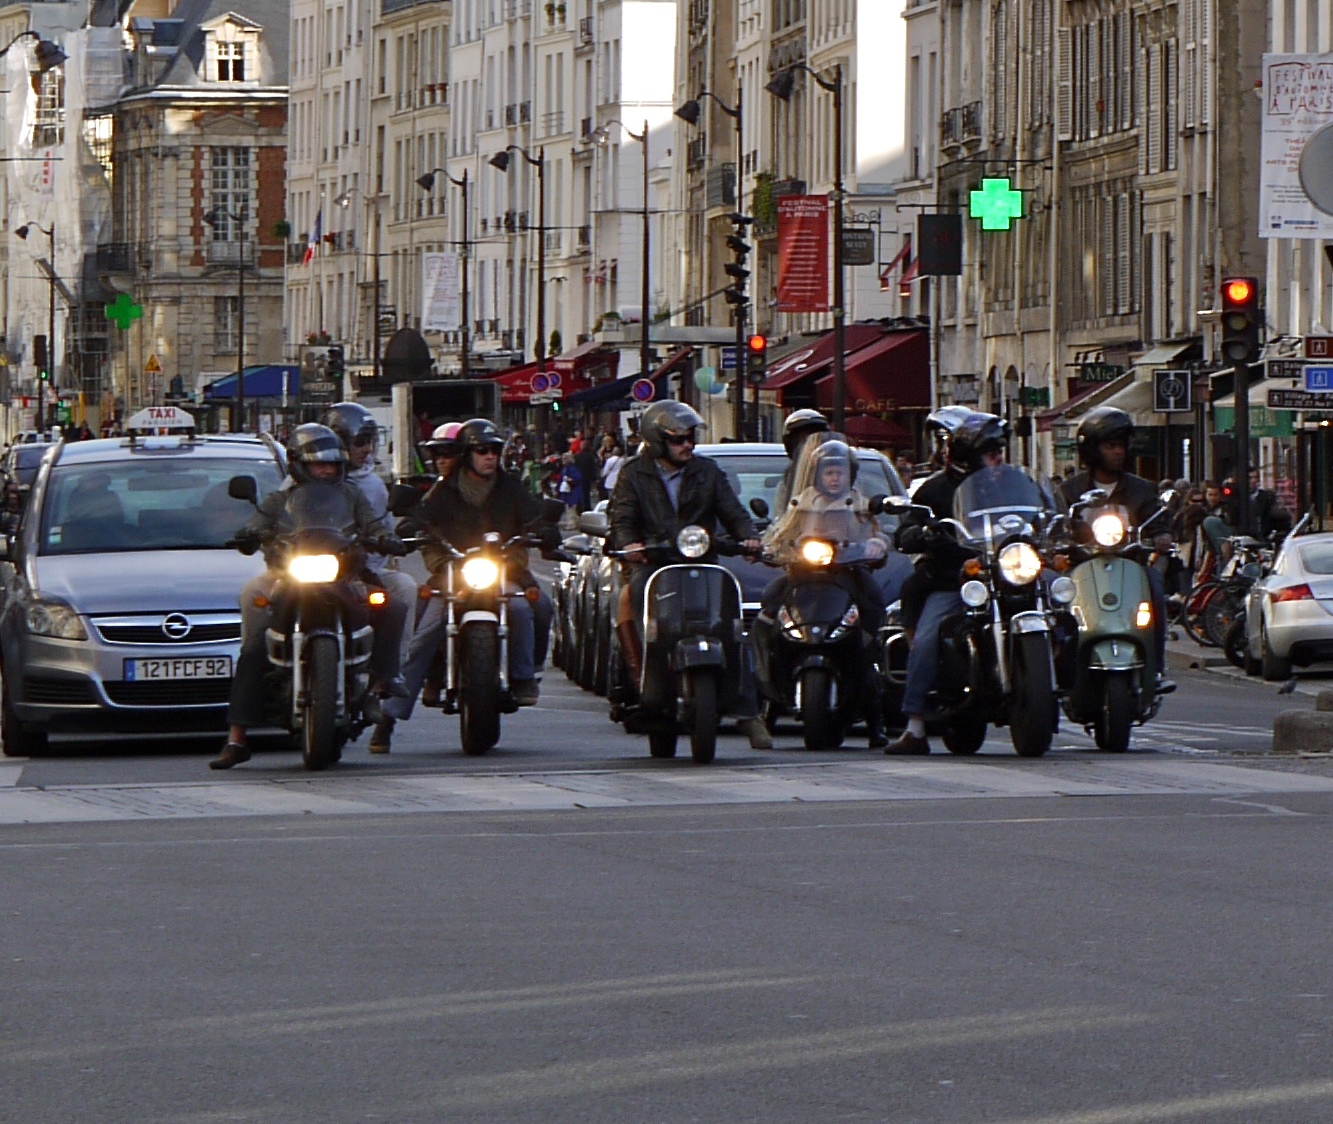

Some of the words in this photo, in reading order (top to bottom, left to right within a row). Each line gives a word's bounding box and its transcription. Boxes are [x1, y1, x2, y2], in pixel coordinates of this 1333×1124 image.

[1275, 68, 1332, 83] FESTIVAL
[1290, 95, 1333, 115] PARIS
[1086, 367, 1118, 381] Miel
[148, 408, 176, 419] TAXI
